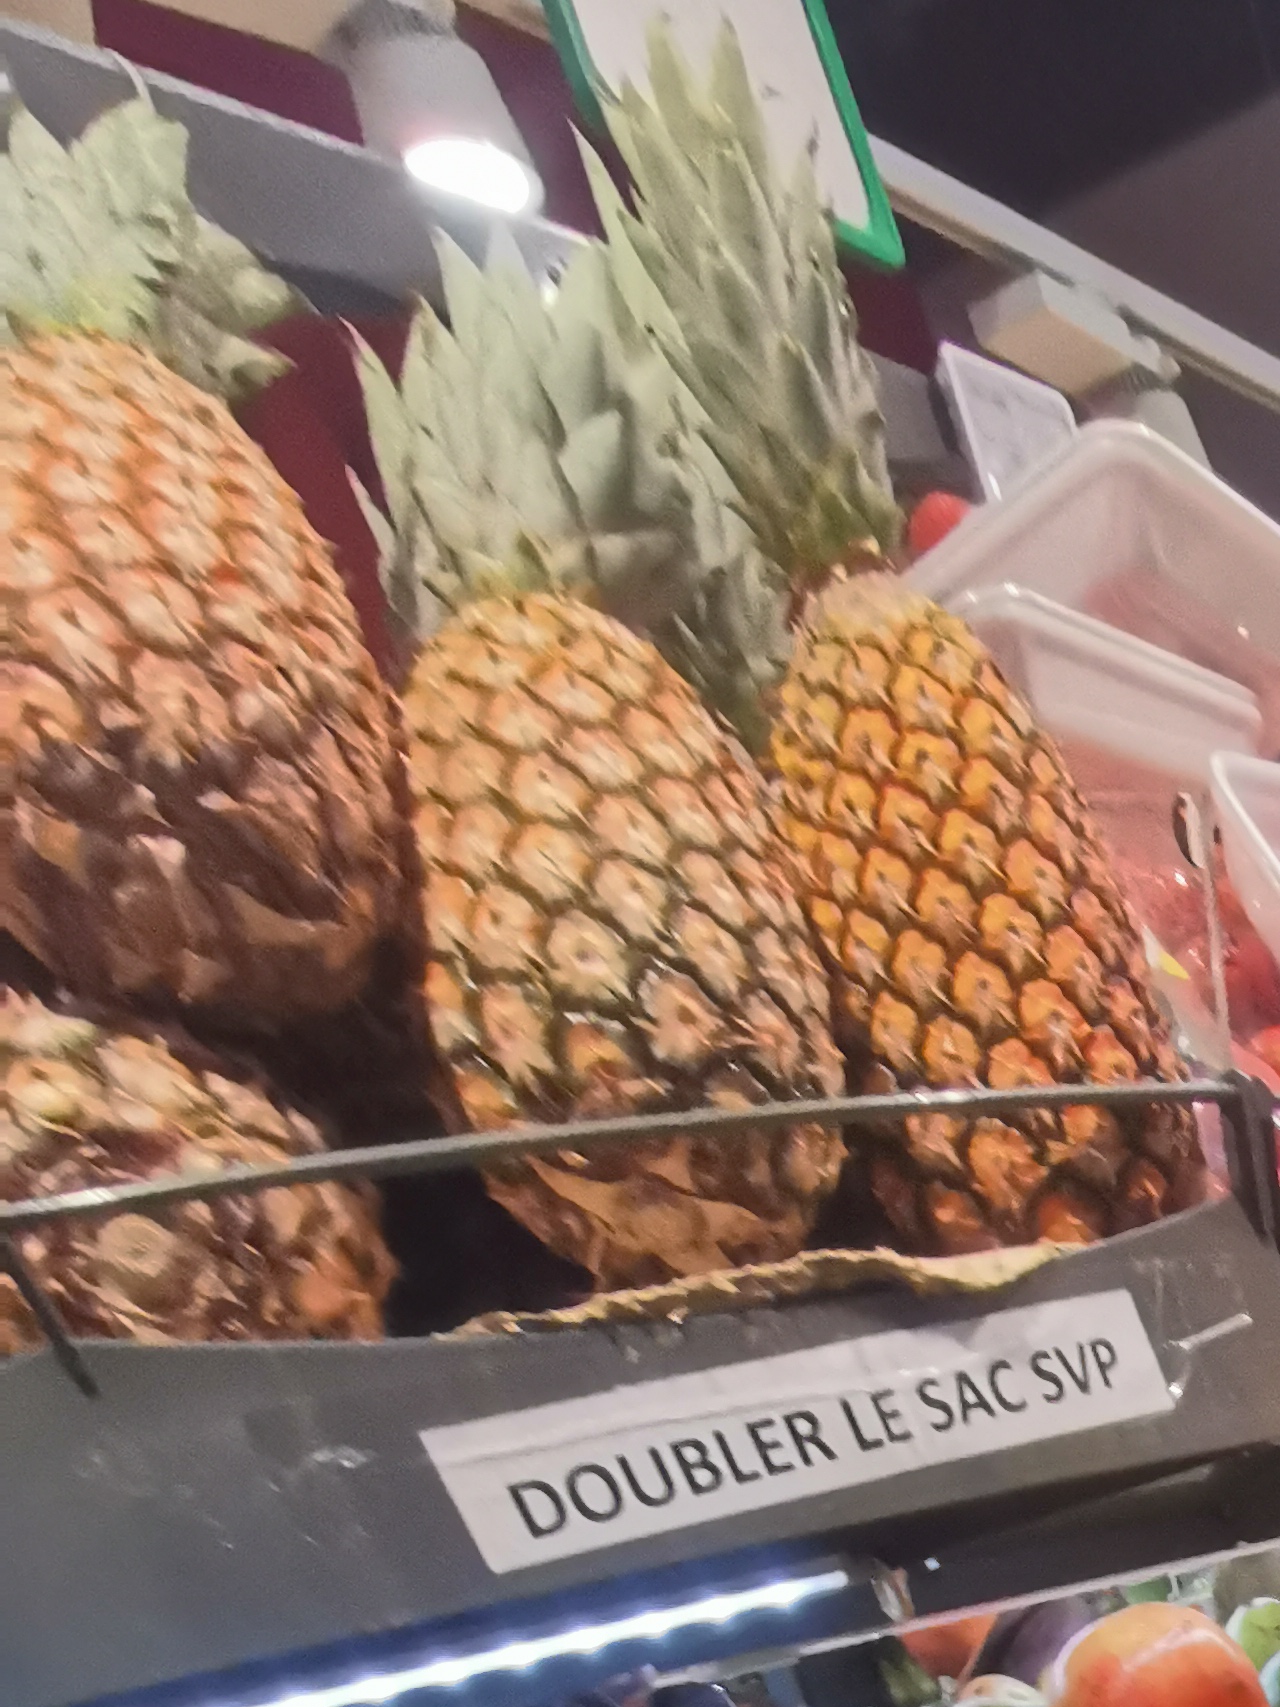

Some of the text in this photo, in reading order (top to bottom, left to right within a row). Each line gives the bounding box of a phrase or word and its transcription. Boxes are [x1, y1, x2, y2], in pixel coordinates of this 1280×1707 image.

[506, 1337, 1118, 1538] DOUBLER LE SAC SVP
